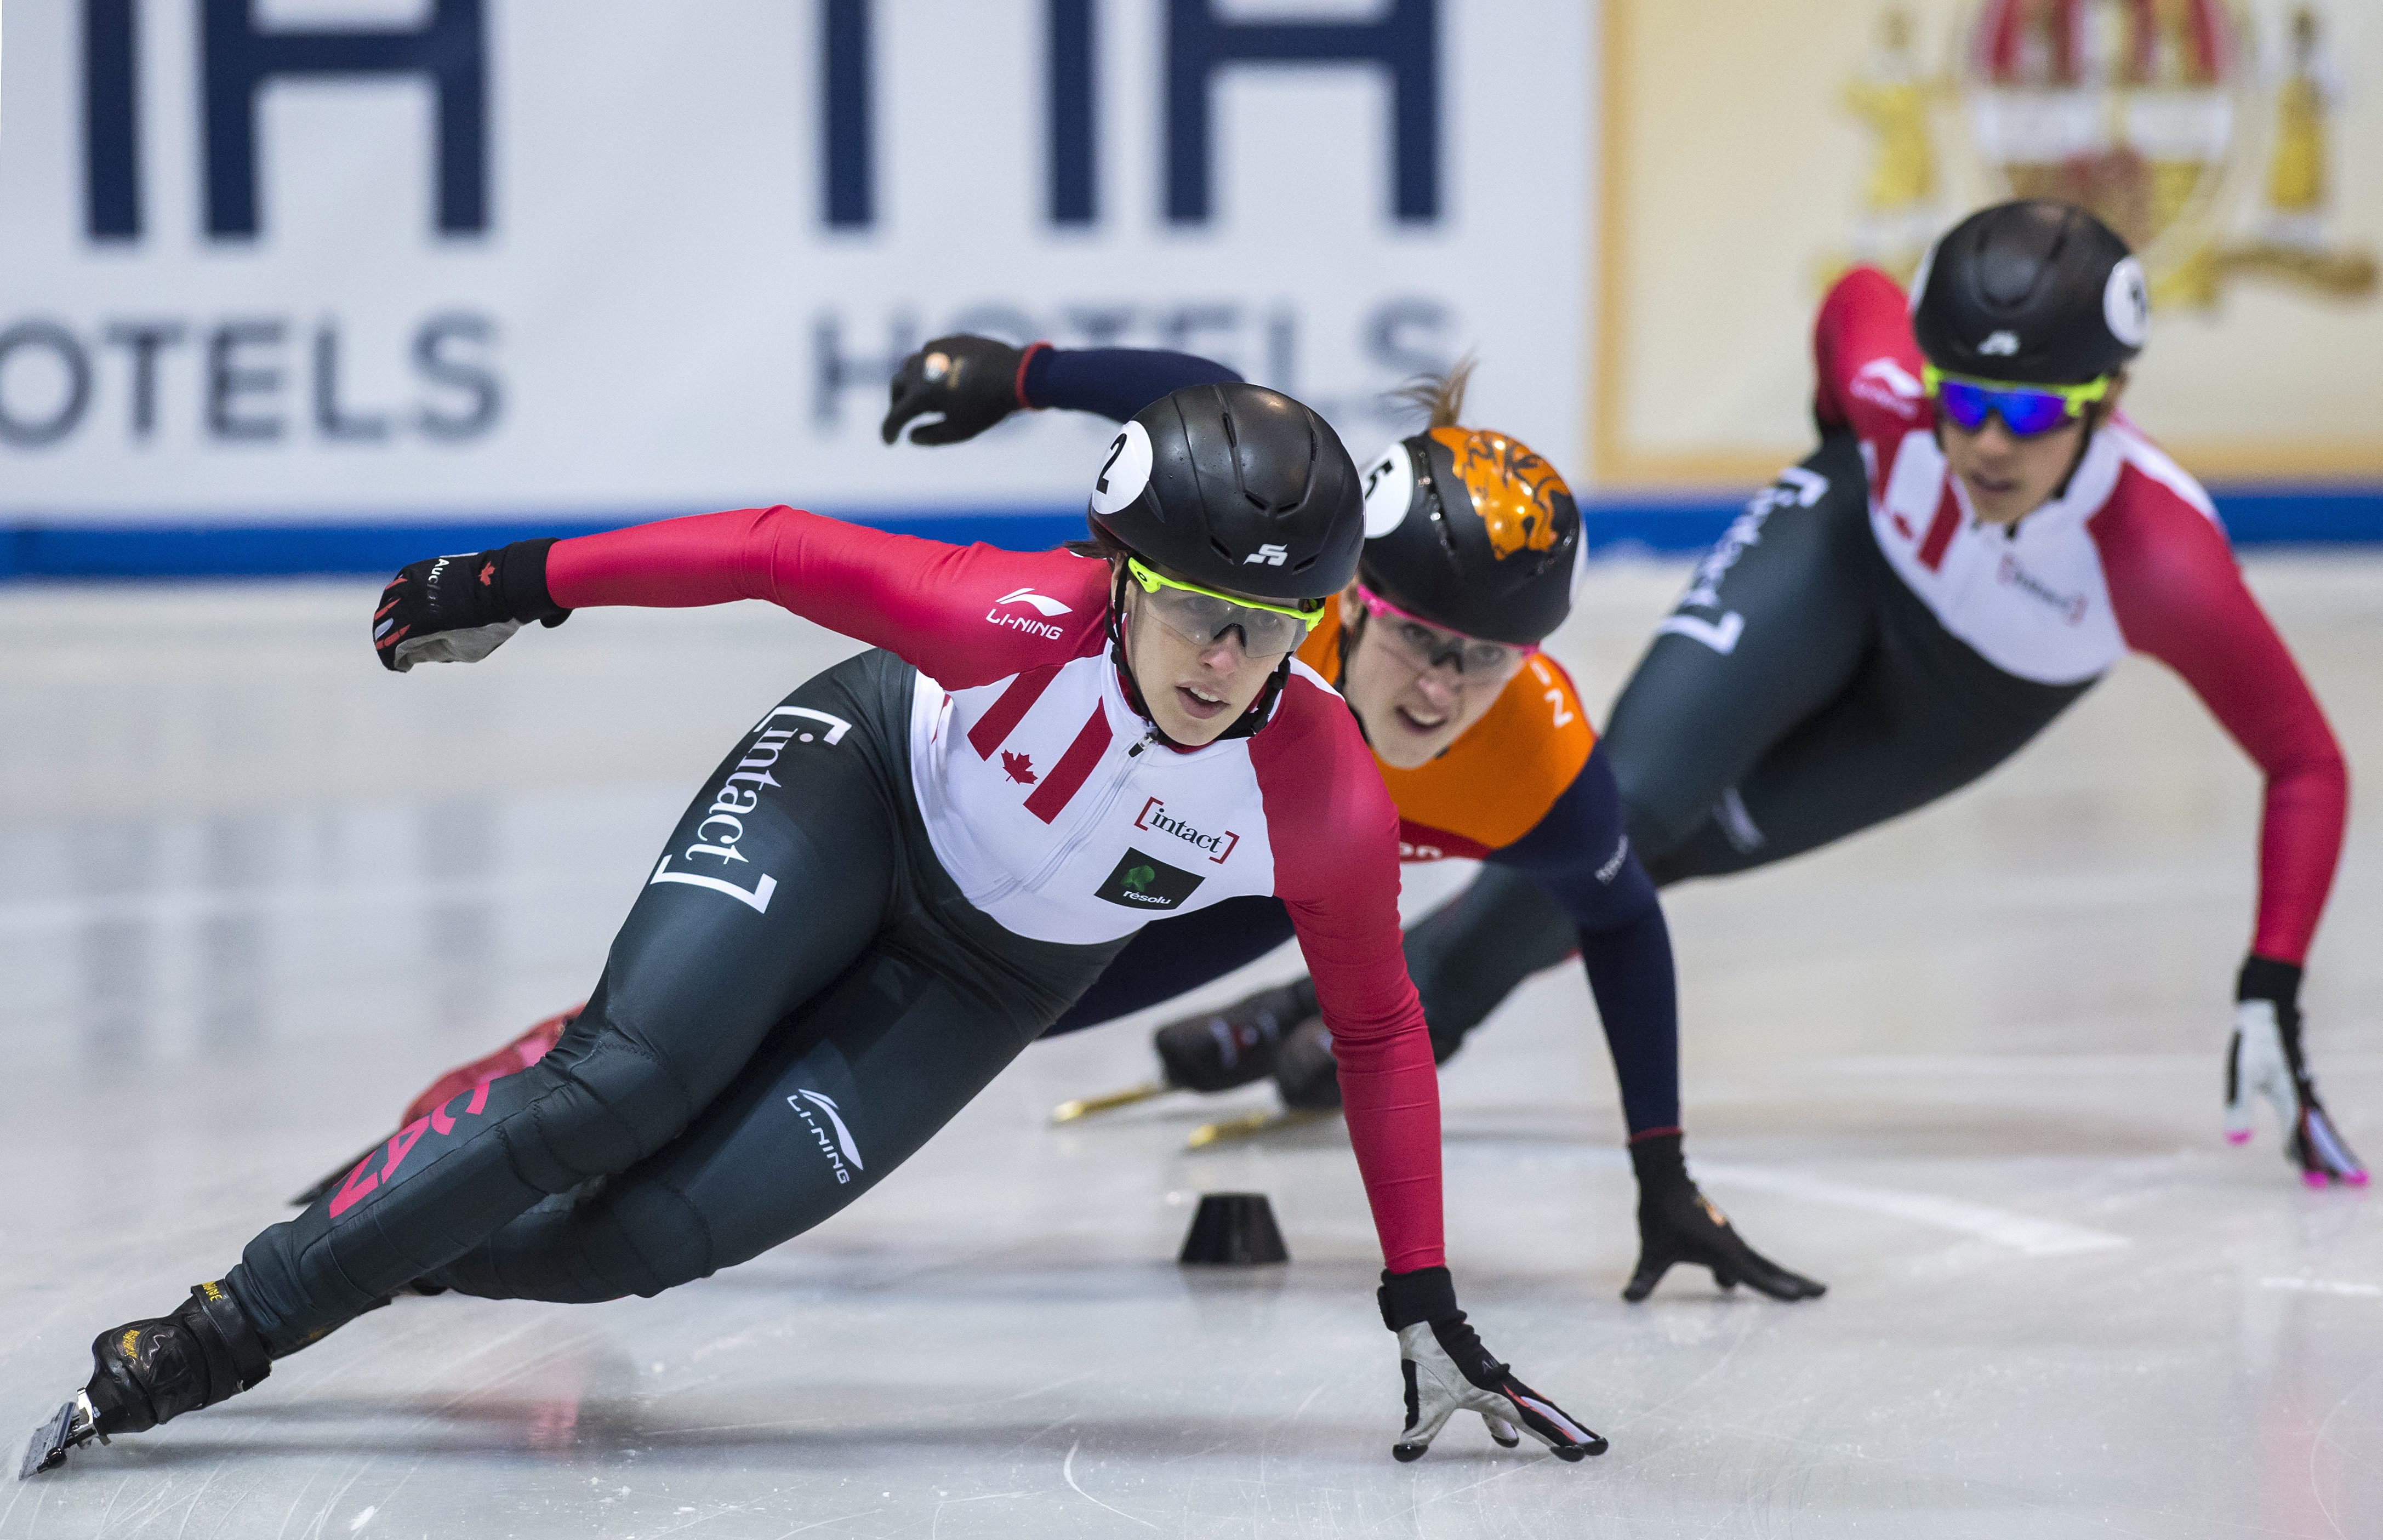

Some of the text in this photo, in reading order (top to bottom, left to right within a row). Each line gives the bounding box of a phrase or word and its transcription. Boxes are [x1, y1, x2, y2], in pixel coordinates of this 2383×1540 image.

[1096, 433, 1127, 495] 2
[985, 608, 1064, 640] LI-NING
[1122, 890, 1172, 904] résolu
[329, 1080, 490, 1219] CAN
[786, 1094, 850, 1184] LI-NING
